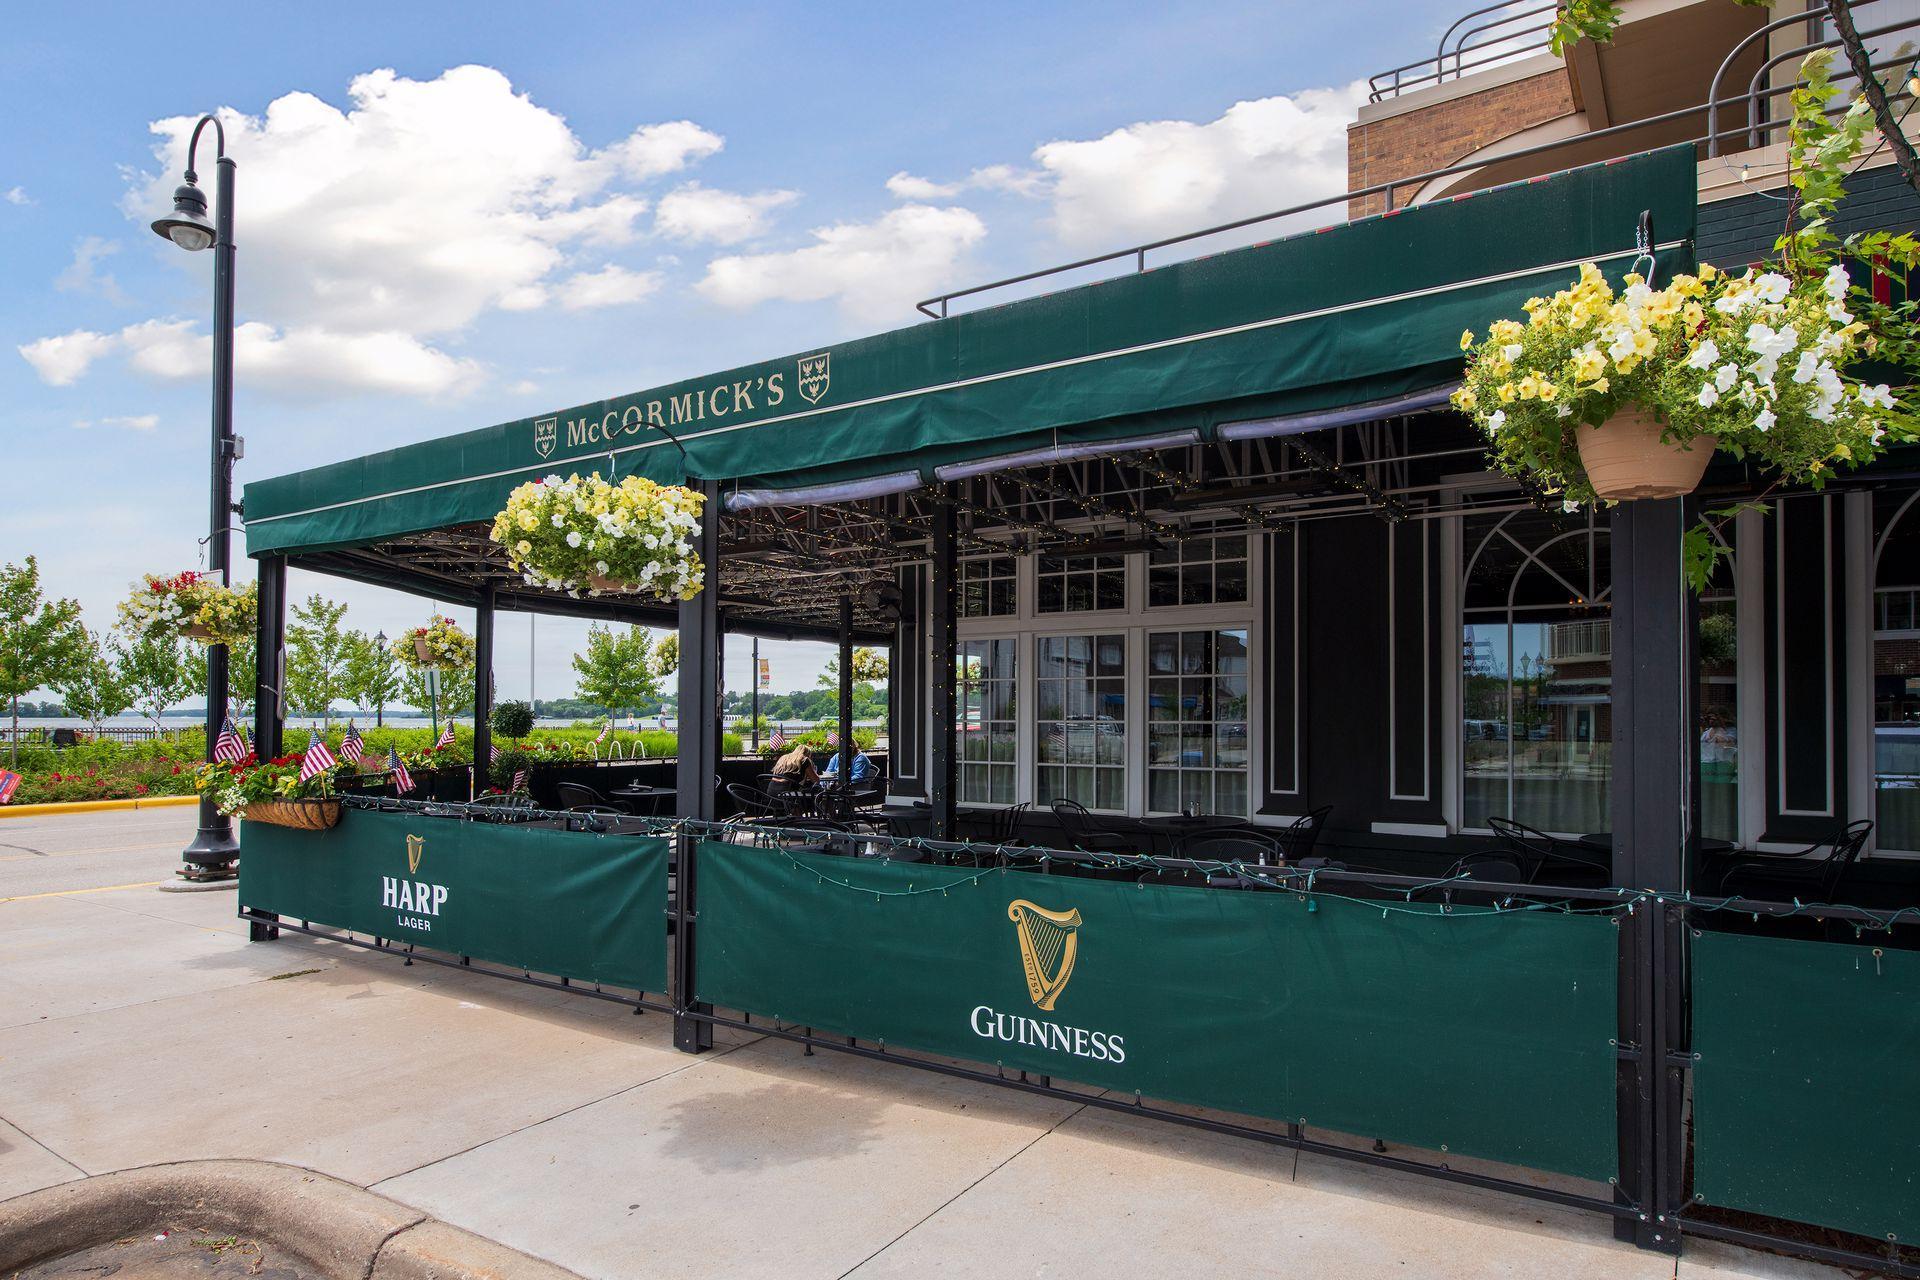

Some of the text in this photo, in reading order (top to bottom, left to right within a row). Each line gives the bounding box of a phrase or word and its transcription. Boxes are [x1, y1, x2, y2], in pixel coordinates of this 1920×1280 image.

[567, 373, 785, 448] McCORMICK'S
[382, 876, 448, 916] HARP
[398, 915, 431, 931] LAGER
[970, 1005, 1126, 1064] GUINNESS
